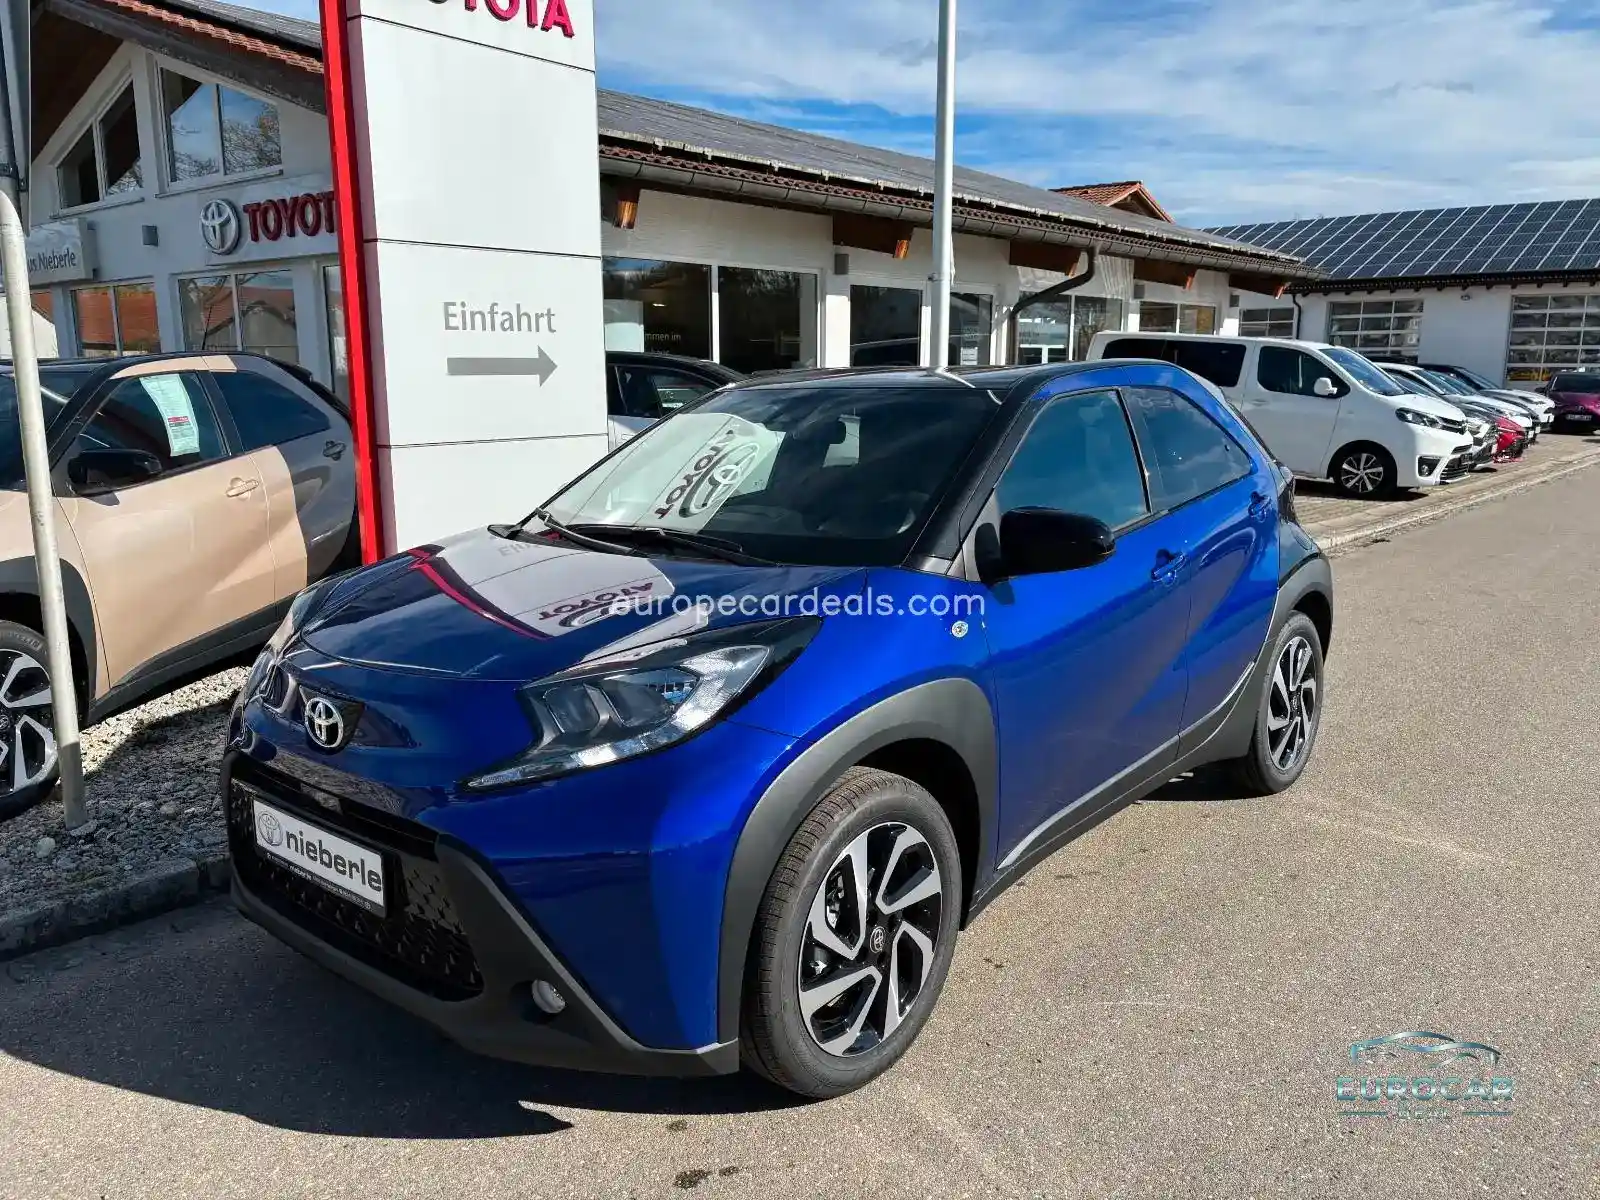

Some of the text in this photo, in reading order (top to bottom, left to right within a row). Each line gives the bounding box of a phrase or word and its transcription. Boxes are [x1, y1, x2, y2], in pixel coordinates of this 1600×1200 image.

[38, 247, 77, 271] Nieberle
[443, 300, 557, 333] Einfahrt
[285, 830, 382, 892] nieberle
